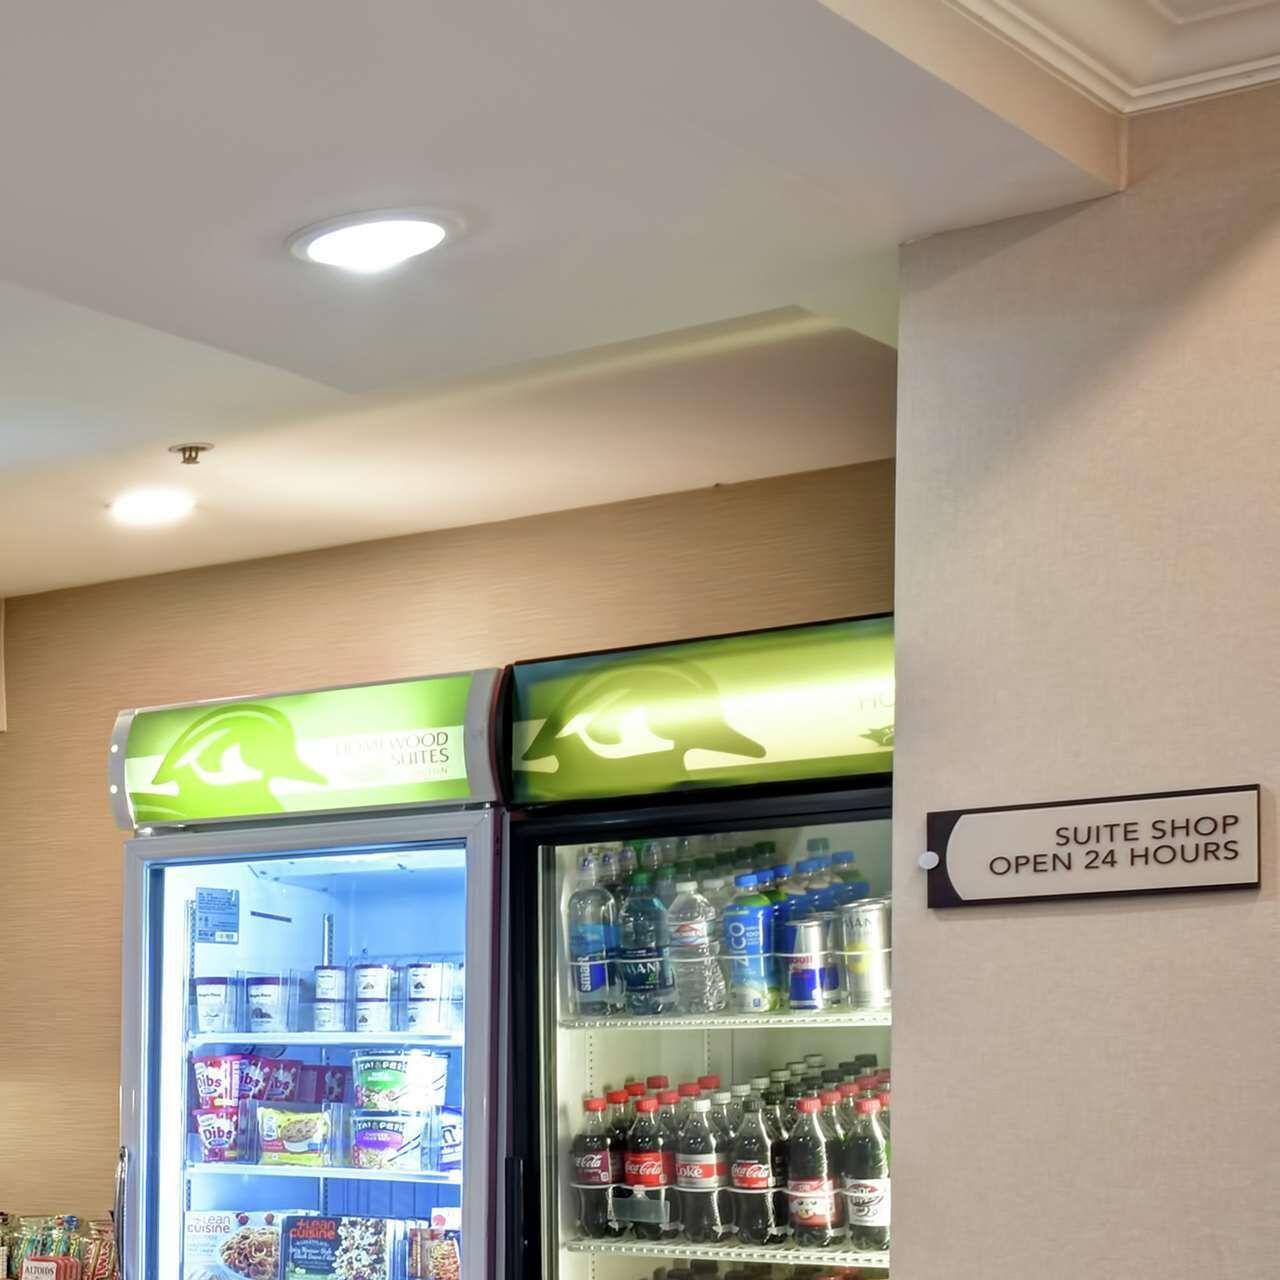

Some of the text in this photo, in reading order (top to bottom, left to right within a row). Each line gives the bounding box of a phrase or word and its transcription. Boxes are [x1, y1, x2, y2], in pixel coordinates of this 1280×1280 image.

[390, 747, 450, 766] SUITES
[1055, 814, 1240, 847] SUITE SHOP
[989, 839, 1240, 876] OPEN 24 HOURS
[204, 1125, 233, 1140] Dibs
